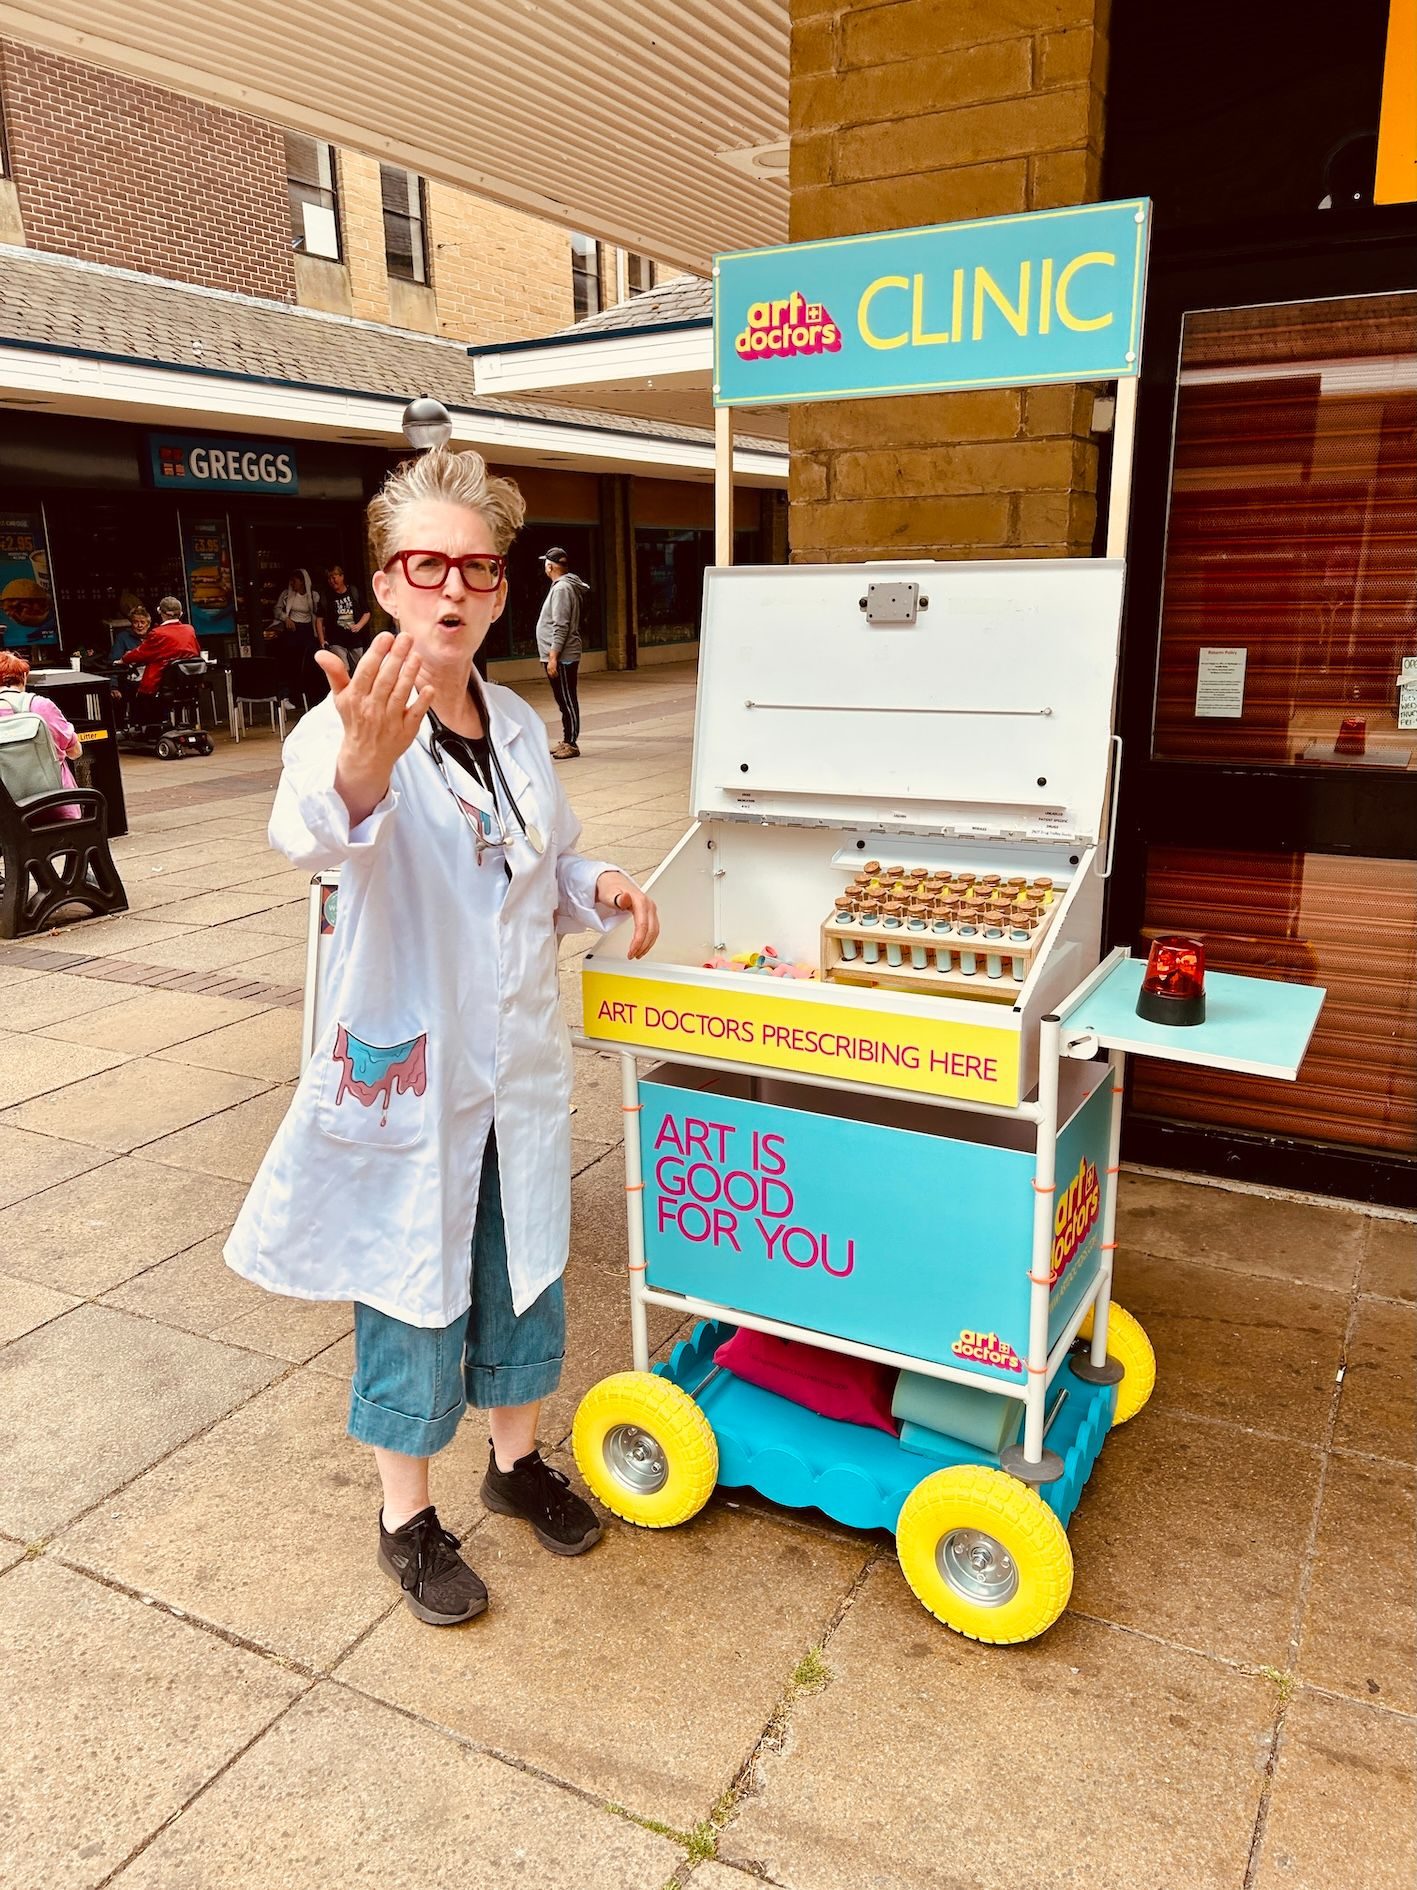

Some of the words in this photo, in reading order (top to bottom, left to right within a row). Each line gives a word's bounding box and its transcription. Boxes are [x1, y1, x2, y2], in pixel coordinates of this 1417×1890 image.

[747, 291, 802, 328] art
[857, 252, 1115, 350] CLINIC
[735, 322, 837, 354] doctors
[190, 448, 293, 484] GREGGS
[80, 733, 97, 741] Litter
[597, 1000, 638, 1024] ART
[645, 1006, 754, 1043] DOCTORS
[762, 1024, 920, 1069] PRESCRIBING
[929, 1049, 998, 1082] HERE
[654, 1113, 736, 1163] ART
[752, 1131, 786, 1175] IS
[655, 1156, 794, 1219] GOOD
[1055, 1156, 1087, 1236] art
[658, 1195, 742, 1252] FOR
[754, 1217, 855, 1278] YOU
[951, 1340, 1019, 1368] doctors
[960, 1329, 998, 1350] art
